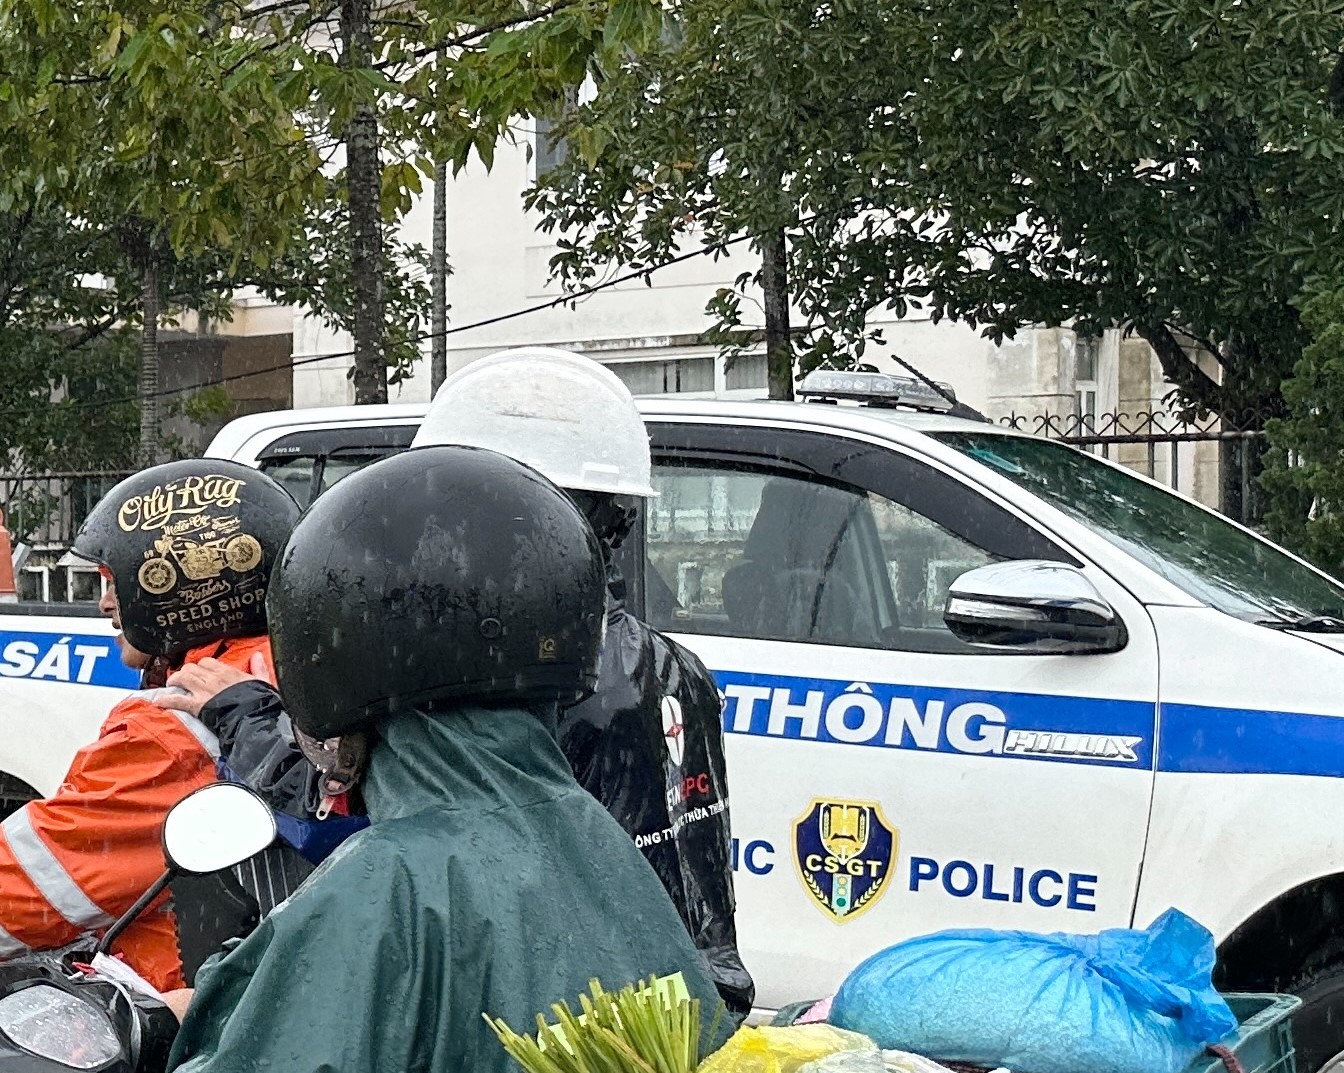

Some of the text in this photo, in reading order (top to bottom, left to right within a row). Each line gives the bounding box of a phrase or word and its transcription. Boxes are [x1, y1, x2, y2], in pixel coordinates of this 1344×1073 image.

[176, 475, 246, 507] Rag
[156, 588, 265, 627] SPEED SHOP
[187, 611, 244, 633] ENGLAND
[724, 683, 1007, 754] THÔNG
[1006, 730, 1143, 761] HILUX
[635, 831, 661, 848] ÔNG
[909, 855, 1098, 912] POLICE
